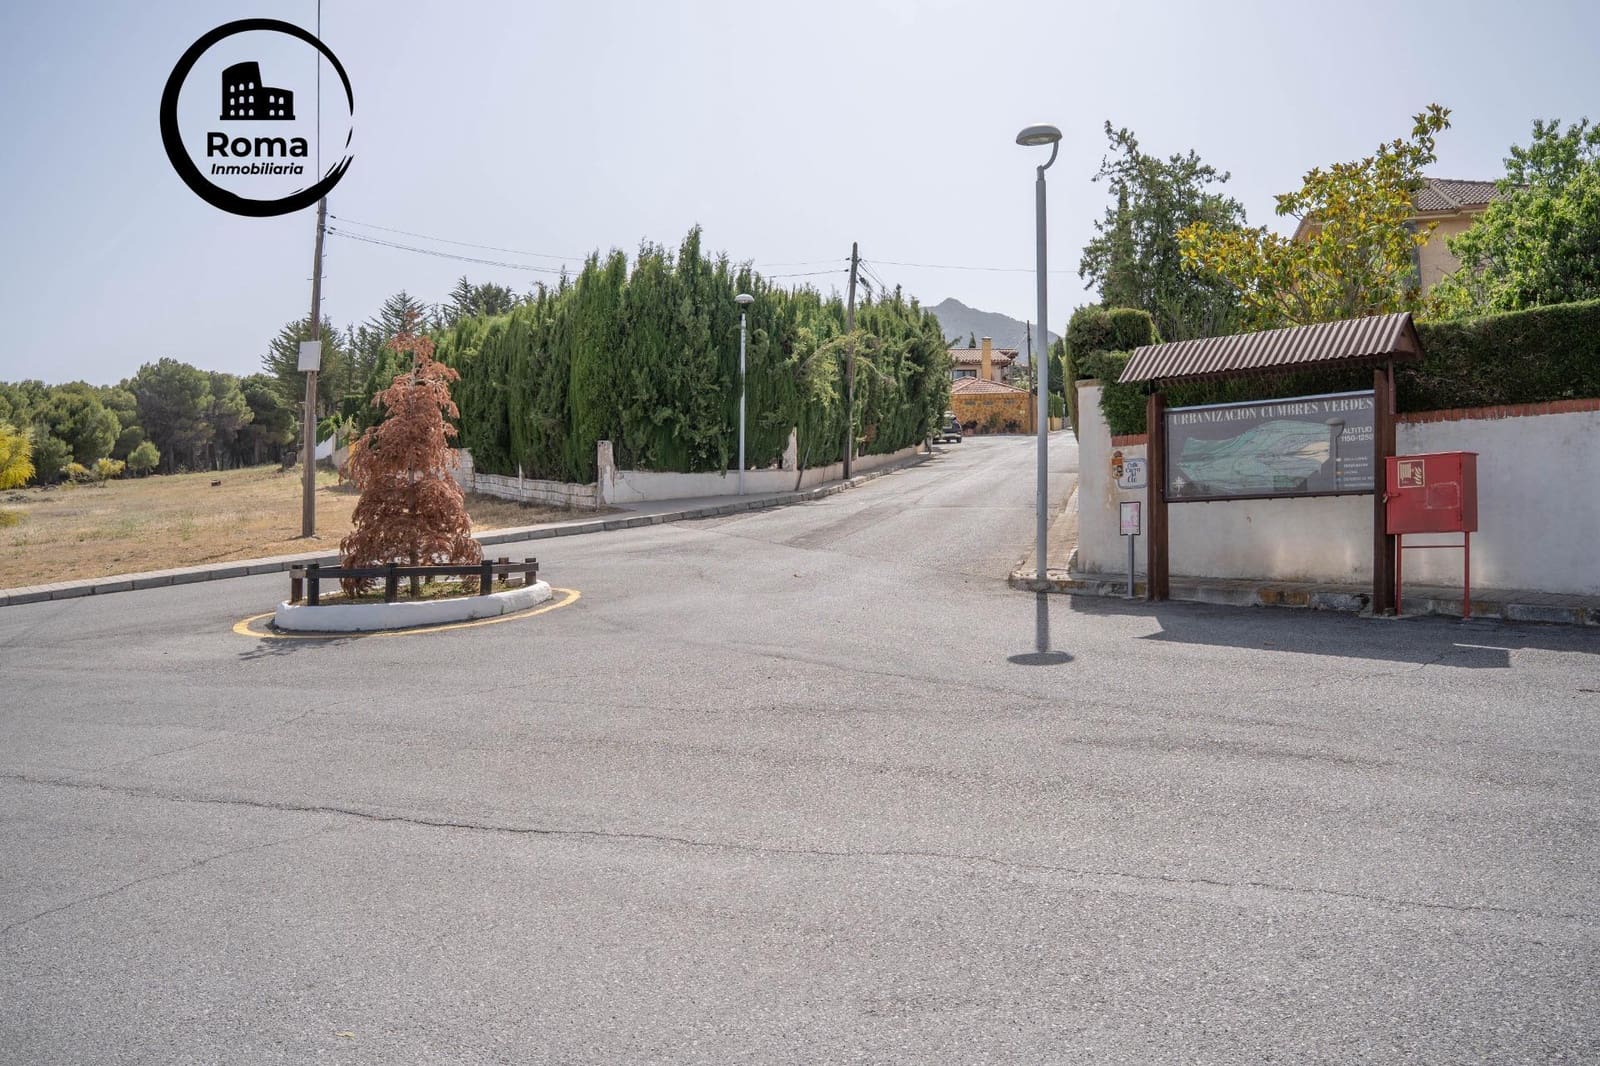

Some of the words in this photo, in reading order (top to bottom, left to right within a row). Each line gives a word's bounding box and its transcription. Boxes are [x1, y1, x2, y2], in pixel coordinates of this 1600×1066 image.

[1173, 407, 1257, 425] URBANIZACION
[1261, 401, 1319, 418] CUMBRES
[1323, 397, 1374, 413] VERDES
